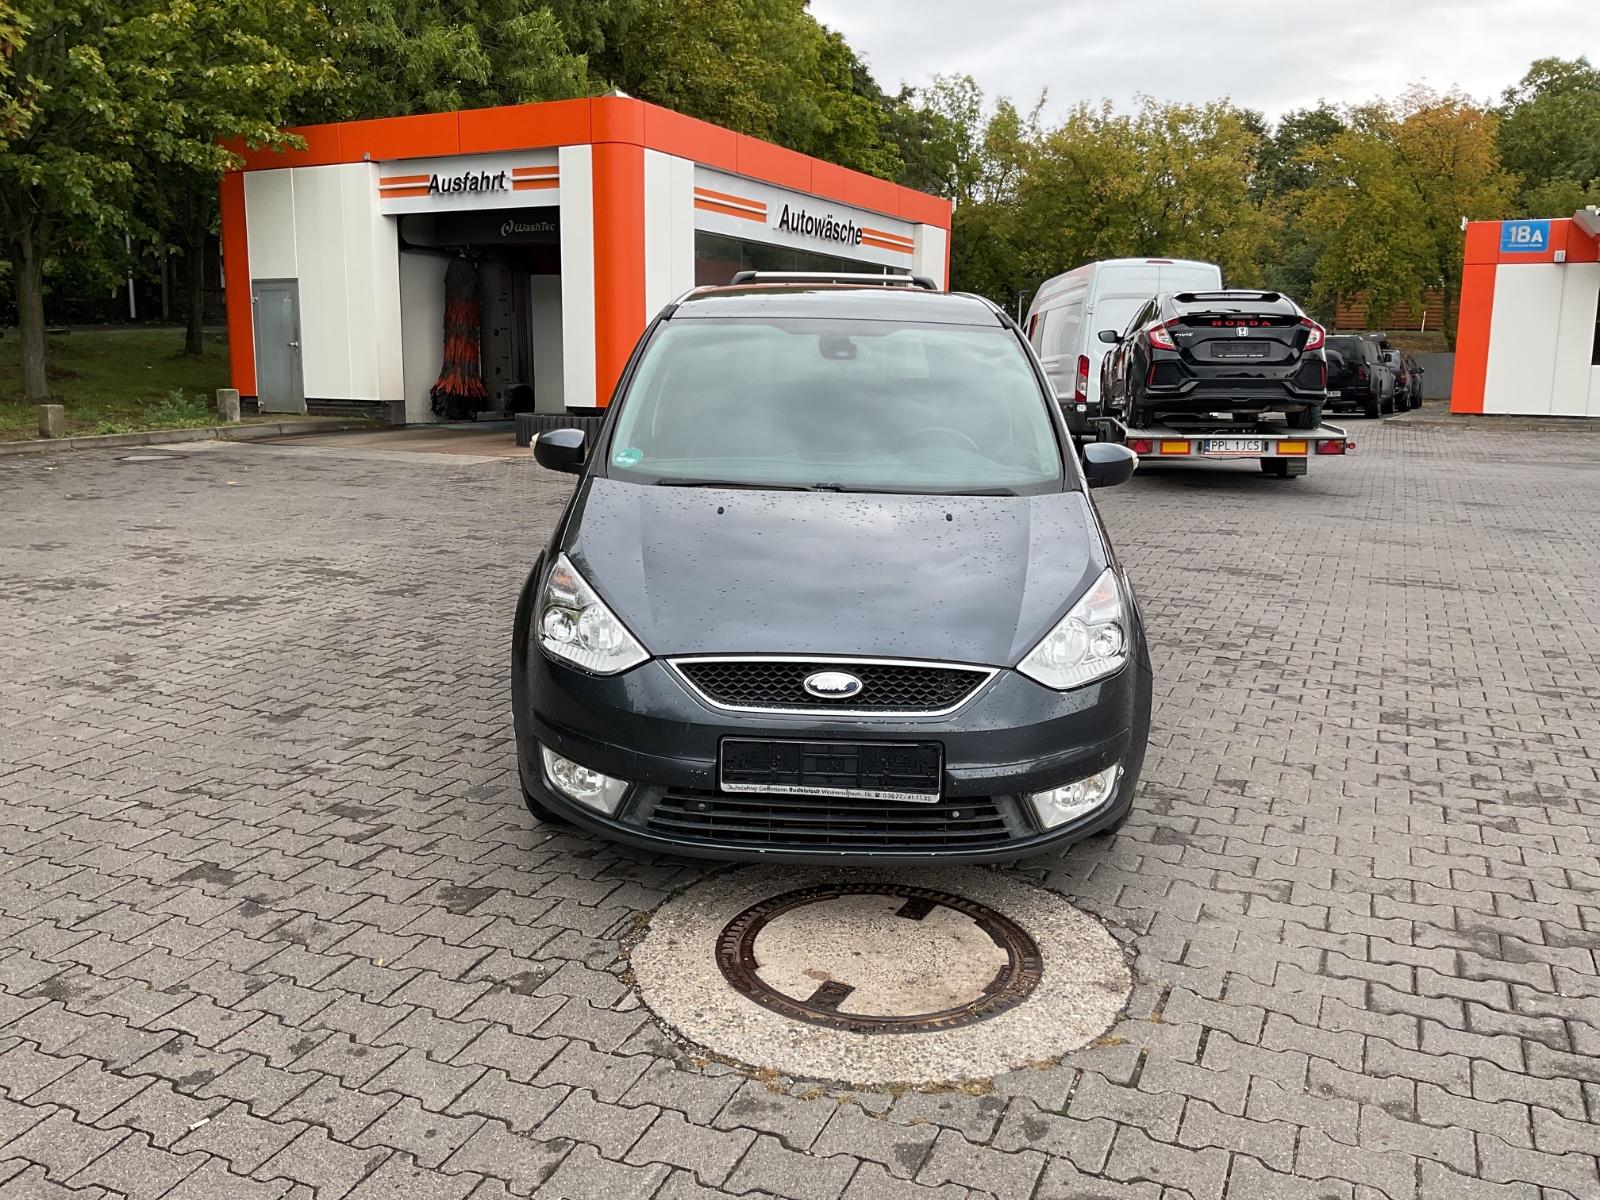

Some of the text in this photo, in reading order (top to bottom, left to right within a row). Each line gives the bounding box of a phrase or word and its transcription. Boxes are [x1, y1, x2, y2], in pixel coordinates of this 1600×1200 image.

[427, 170, 506, 194] Ausfahrt
[514, 221, 556, 232] WashTec
[779, 203, 863, 246] Autowäsche
[1510, 225, 1543, 243] 18A
[1211, 440, 1231, 451] PPL
